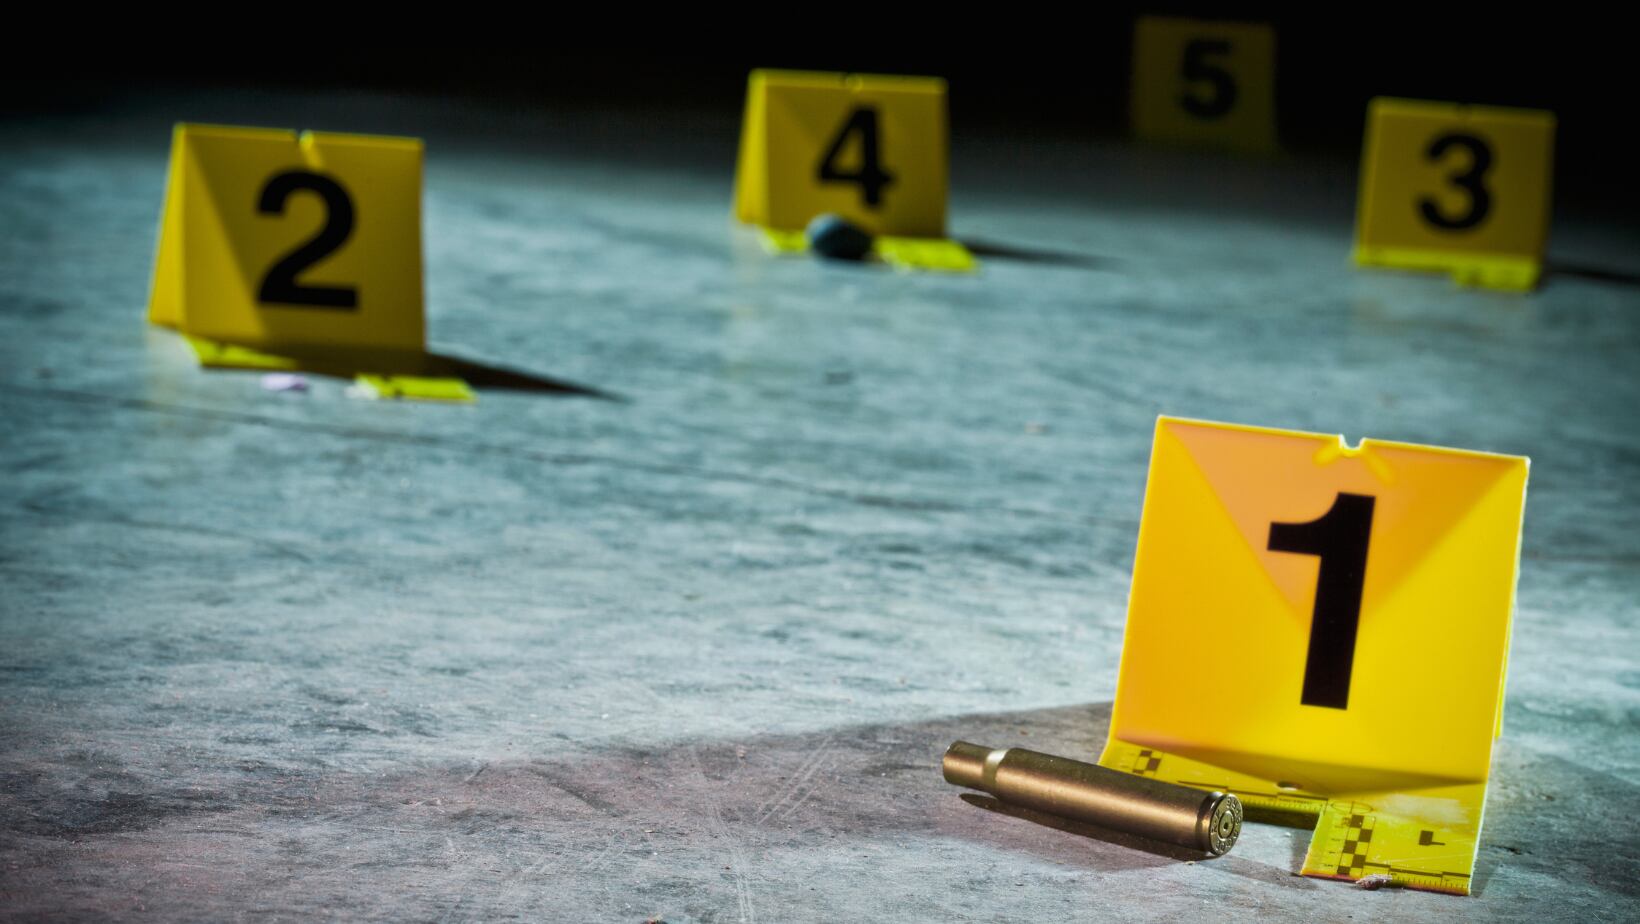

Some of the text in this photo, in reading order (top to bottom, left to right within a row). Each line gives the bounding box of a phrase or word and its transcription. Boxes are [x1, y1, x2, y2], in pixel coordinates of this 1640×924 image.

[1179, 38, 1239, 121] 5
[817, 105, 896, 208] 4
[1418, 131, 1496, 233] 3
[256, 169, 359, 312] 2
[1268, 493, 1375, 709] 1
